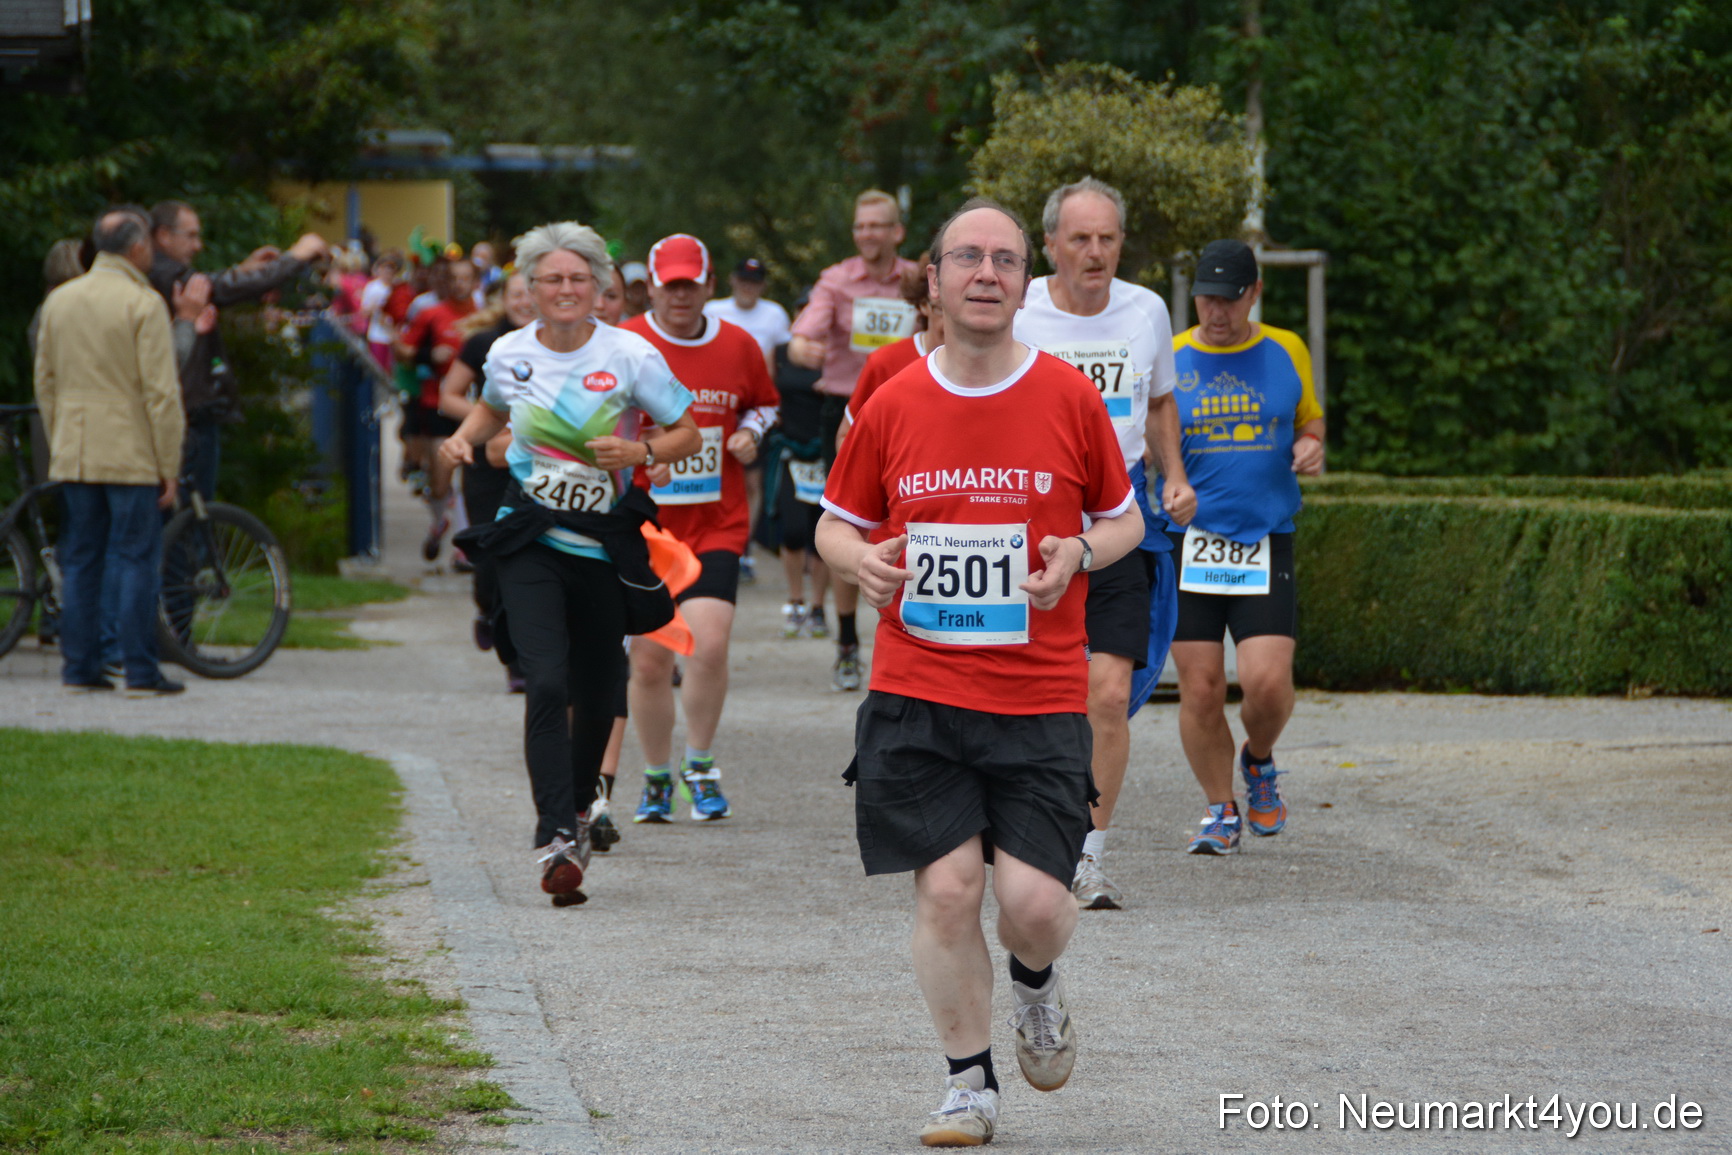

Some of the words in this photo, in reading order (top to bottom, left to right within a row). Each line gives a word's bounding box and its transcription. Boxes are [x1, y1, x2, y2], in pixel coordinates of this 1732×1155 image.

[865, 310, 903, 333] 367
[1074, 350, 1116, 359] Neumarkt
[533, 474, 605, 512] 2462
[898, 468, 1029, 498] NEUMARKT
[1003, 497, 1028, 505] STADT
[909, 534, 942, 547] PARTL
[944, 536, 1004, 548] Neumarkt
[1192, 537, 1261, 566] 2382
[916, 553, 1011, 598] 2501
[1205, 571, 1246, 584] Herbert
[938, 609, 985, 628] Frank
